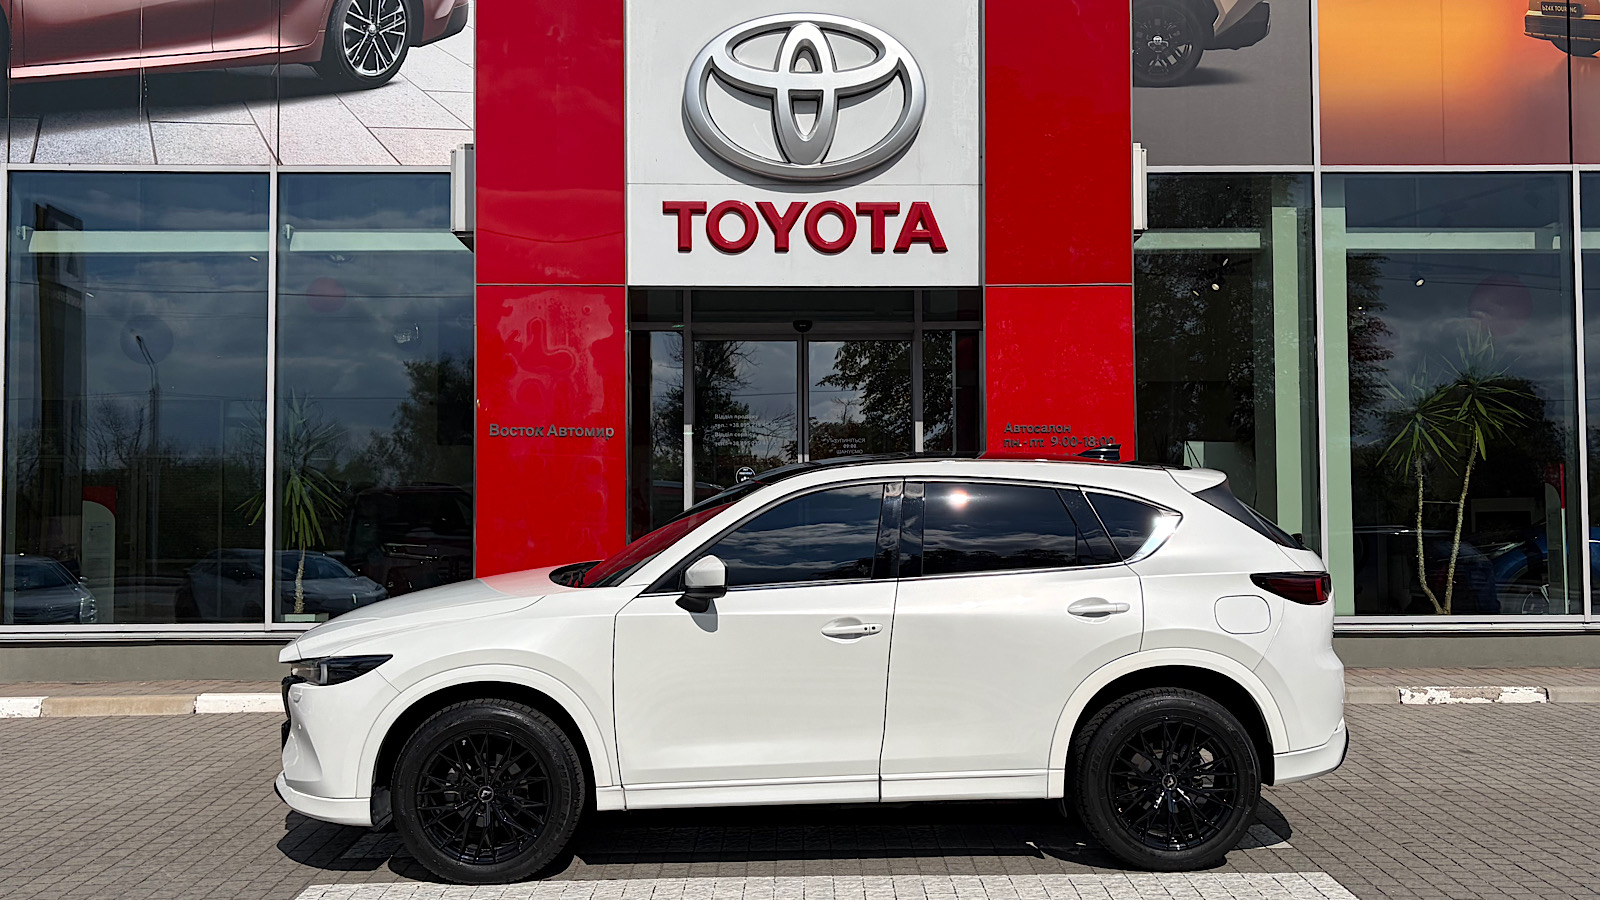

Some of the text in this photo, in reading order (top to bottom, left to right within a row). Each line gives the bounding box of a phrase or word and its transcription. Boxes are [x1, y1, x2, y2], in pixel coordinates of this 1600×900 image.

[662, 200, 949, 254] TOYOTA
[489, 424, 615, 441] Восток Автомир
[1004, 422, 1071, 434] Автосалон
[1050, 436, 1116, 448] 9:00-18:00
